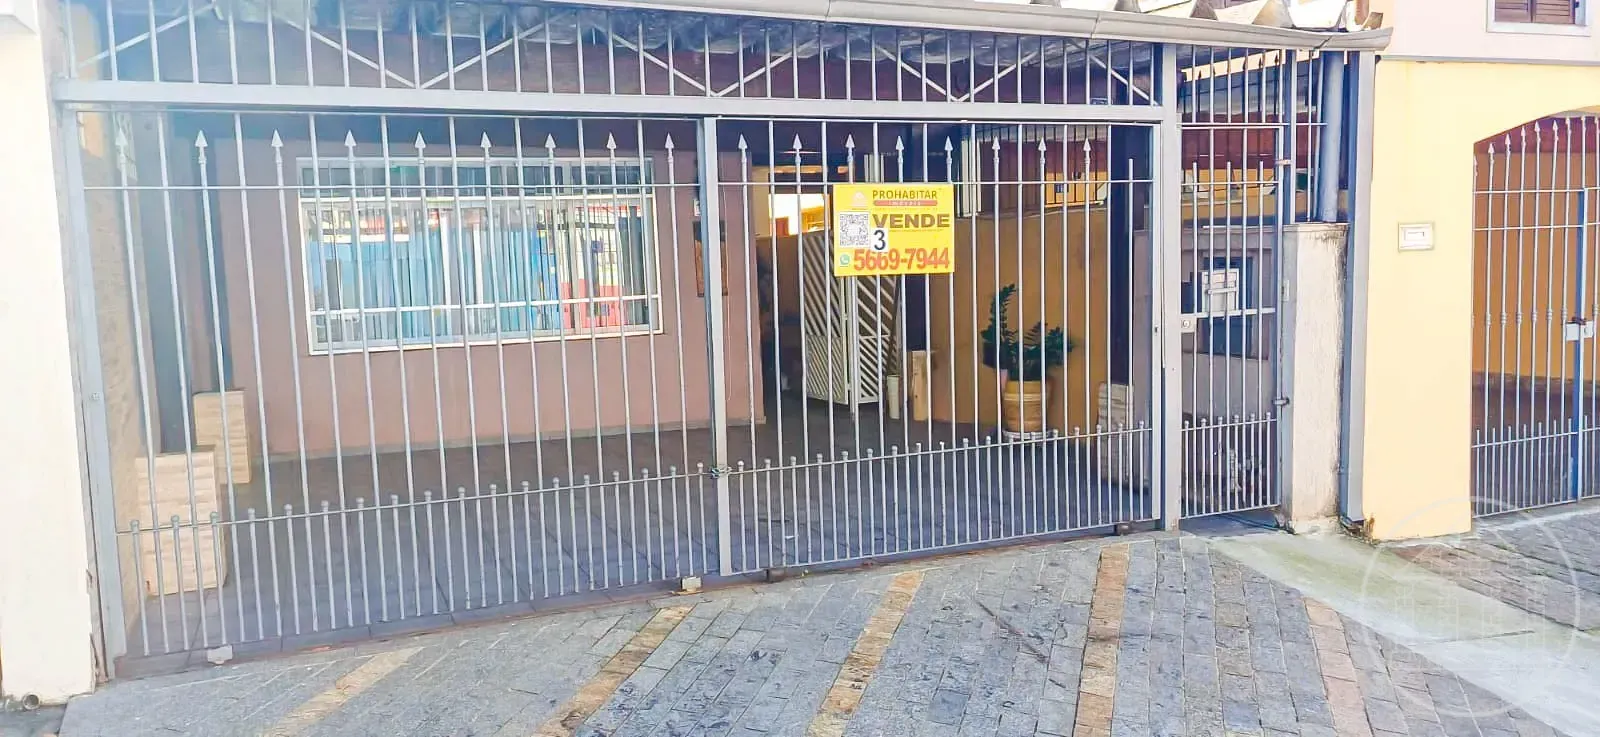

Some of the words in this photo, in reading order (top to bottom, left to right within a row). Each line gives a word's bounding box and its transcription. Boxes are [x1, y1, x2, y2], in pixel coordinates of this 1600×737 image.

[872, 190, 937, 199] PROHABITAR
[872, 213, 950, 228] VENDE
[874, 229, 886, 251] 3
[853, 248, 950, 271] 5669-7944
